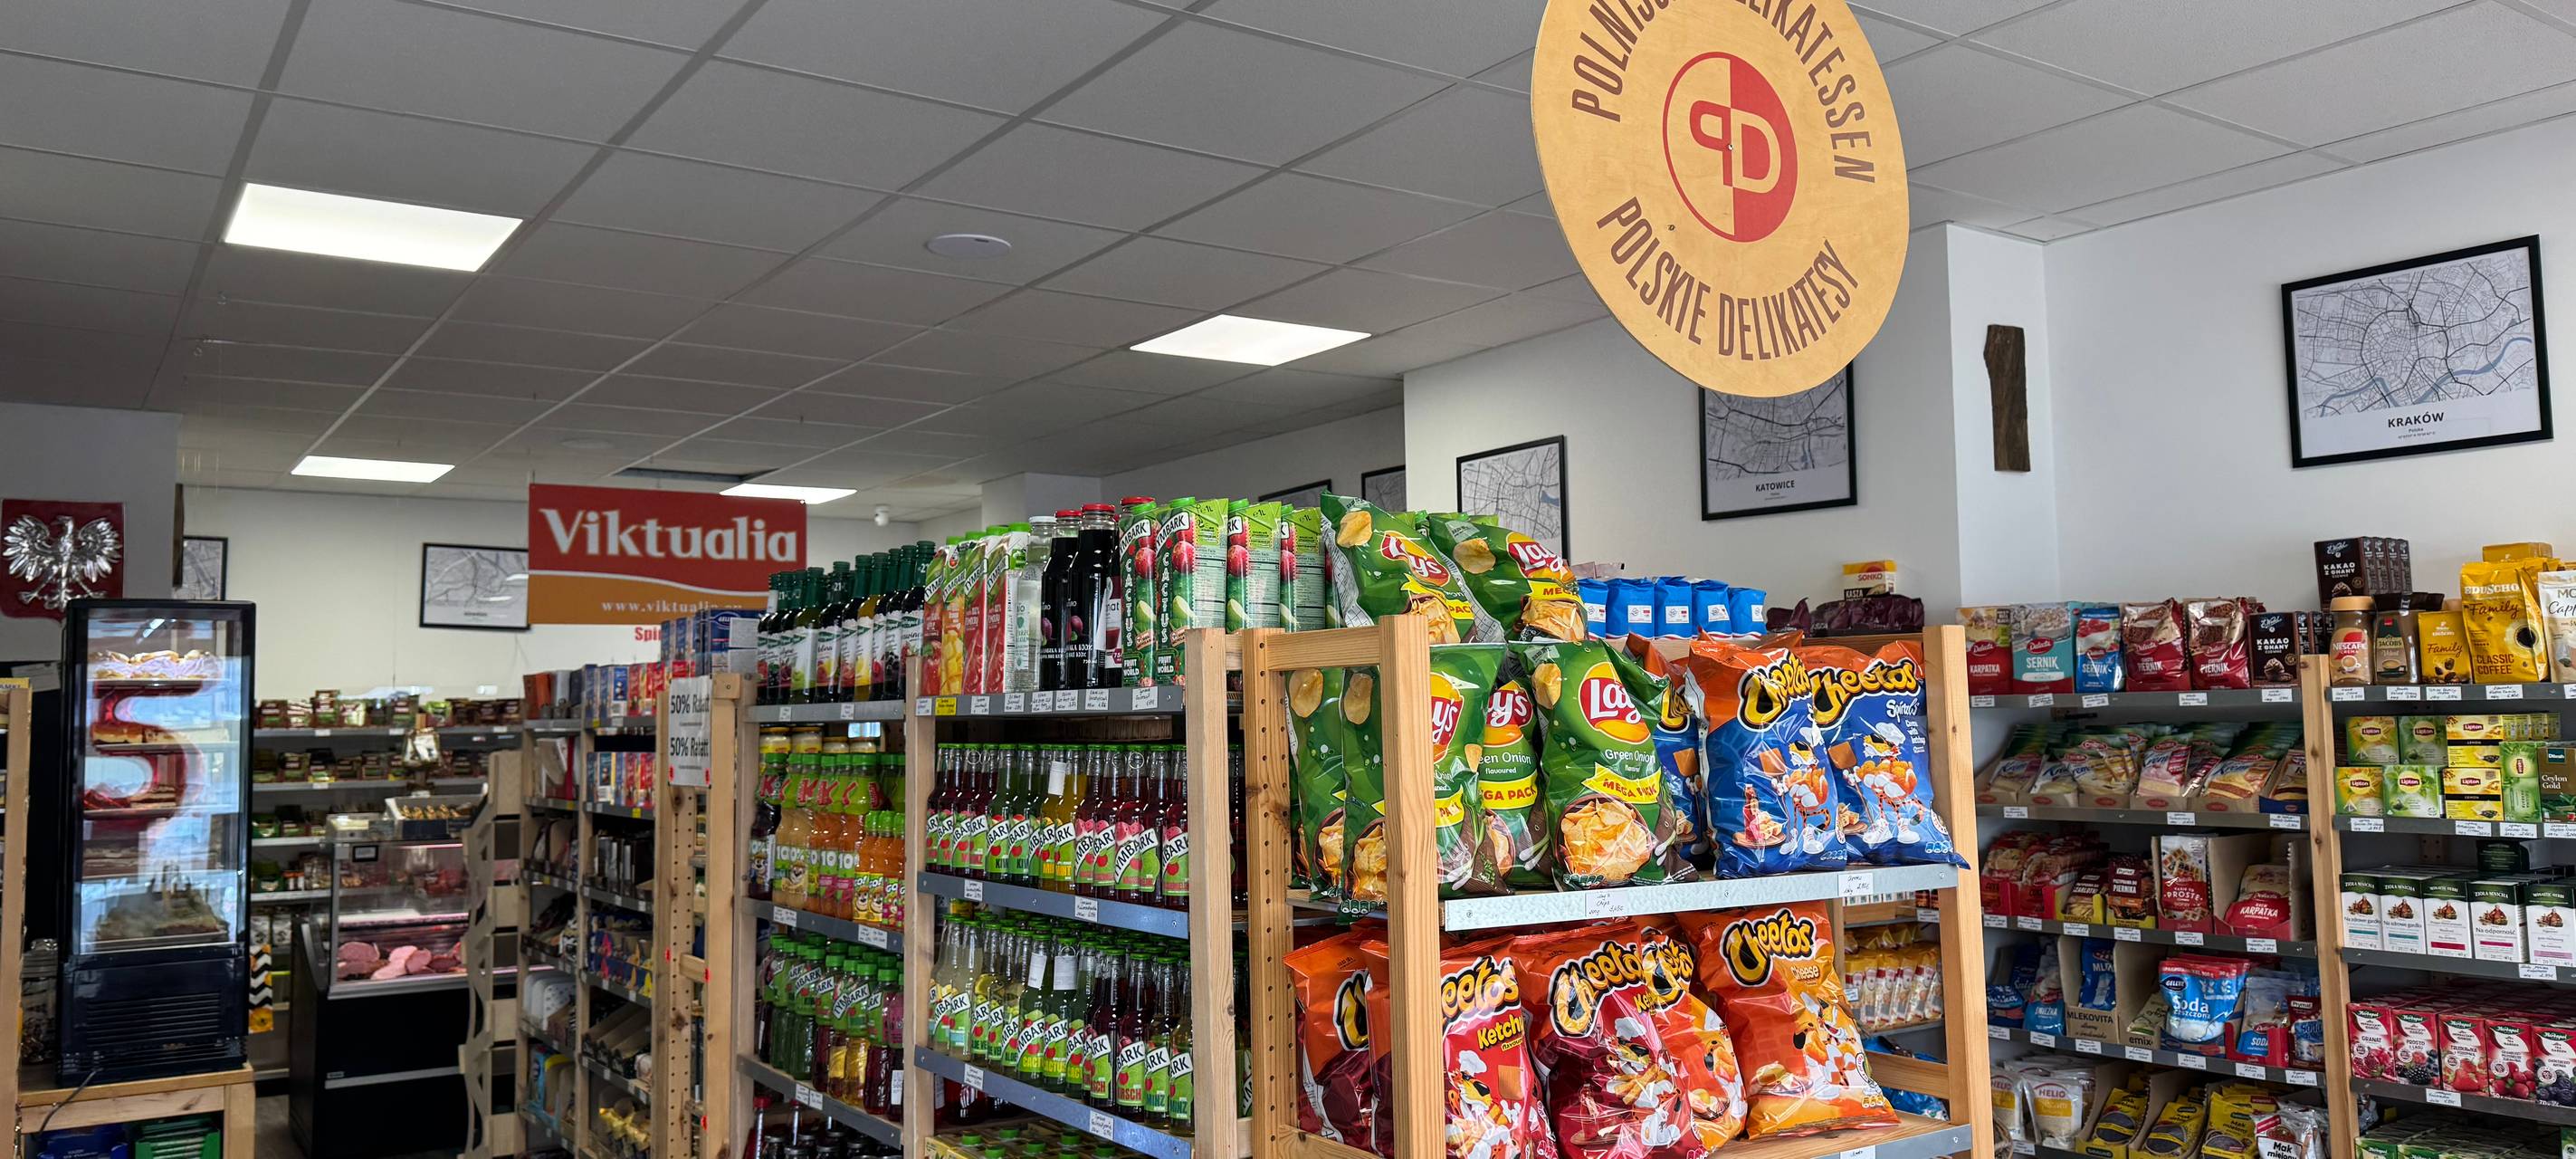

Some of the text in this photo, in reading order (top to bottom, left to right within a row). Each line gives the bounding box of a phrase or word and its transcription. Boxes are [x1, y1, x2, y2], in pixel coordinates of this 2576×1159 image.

[1597, 196, 1858, 360] POLSKIE DELIKATESY
[2388, 411, 2445, 428] KRAKÓW
[1755, 480, 1796, 493] KATOWICE
[539, 508, 797, 562] Viktualia
[2323, 561, 2356, 570] KAKAO
[1857, 572, 1883, 581] SONKO
[2464, 583, 2520, 595] EDUSCHO
[1124, 557, 1134, 647] CACTUS
[1161, 551, 1169, 644] CACTUS
[2469, 600, 2520, 619] Family
[2427, 642, 2464, 658] Family
[2026, 656, 2059, 669] SERNIK
[2476, 654, 2514, 666] CLASSIC
[1970, 664, 2000, 674] KARPATKA
[2477, 665, 2513, 676] COFFEE
[1810, 657, 1921, 730] Cheetos
[671, 694, 691, 714] 50%
[2464, 723, 2484, 732] Lipton
[670, 737, 689, 756] 50%
[1502, 752, 1531, 765] Onion
[1605, 749, 1634, 761] Green
[2399, 778, 2419, 786] Lipton
[2460, 778, 2480, 786] Lipton
[2542, 774, 2568, 784] Ceylon
[1507, 785, 1537, 800] PACK
[1603, 778, 1634, 799] MEGA
[2239, 905, 2278, 919] KARPATKA
[1721, 908, 1816, 989] Cheetos
[1789, 964, 1820, 982] Cheese
[1442, 956, 1522, 1020] eetos
[1550, 940, 1644, 1039] Cheeto
[2173, 995, 2209, 1013] Soda
[2066, 1011, 2113, 1024] MLEKOVITA
[2038, 1088, 2066, 1098] HELIO
[2273, 1140, 2293, 1154] Mak
